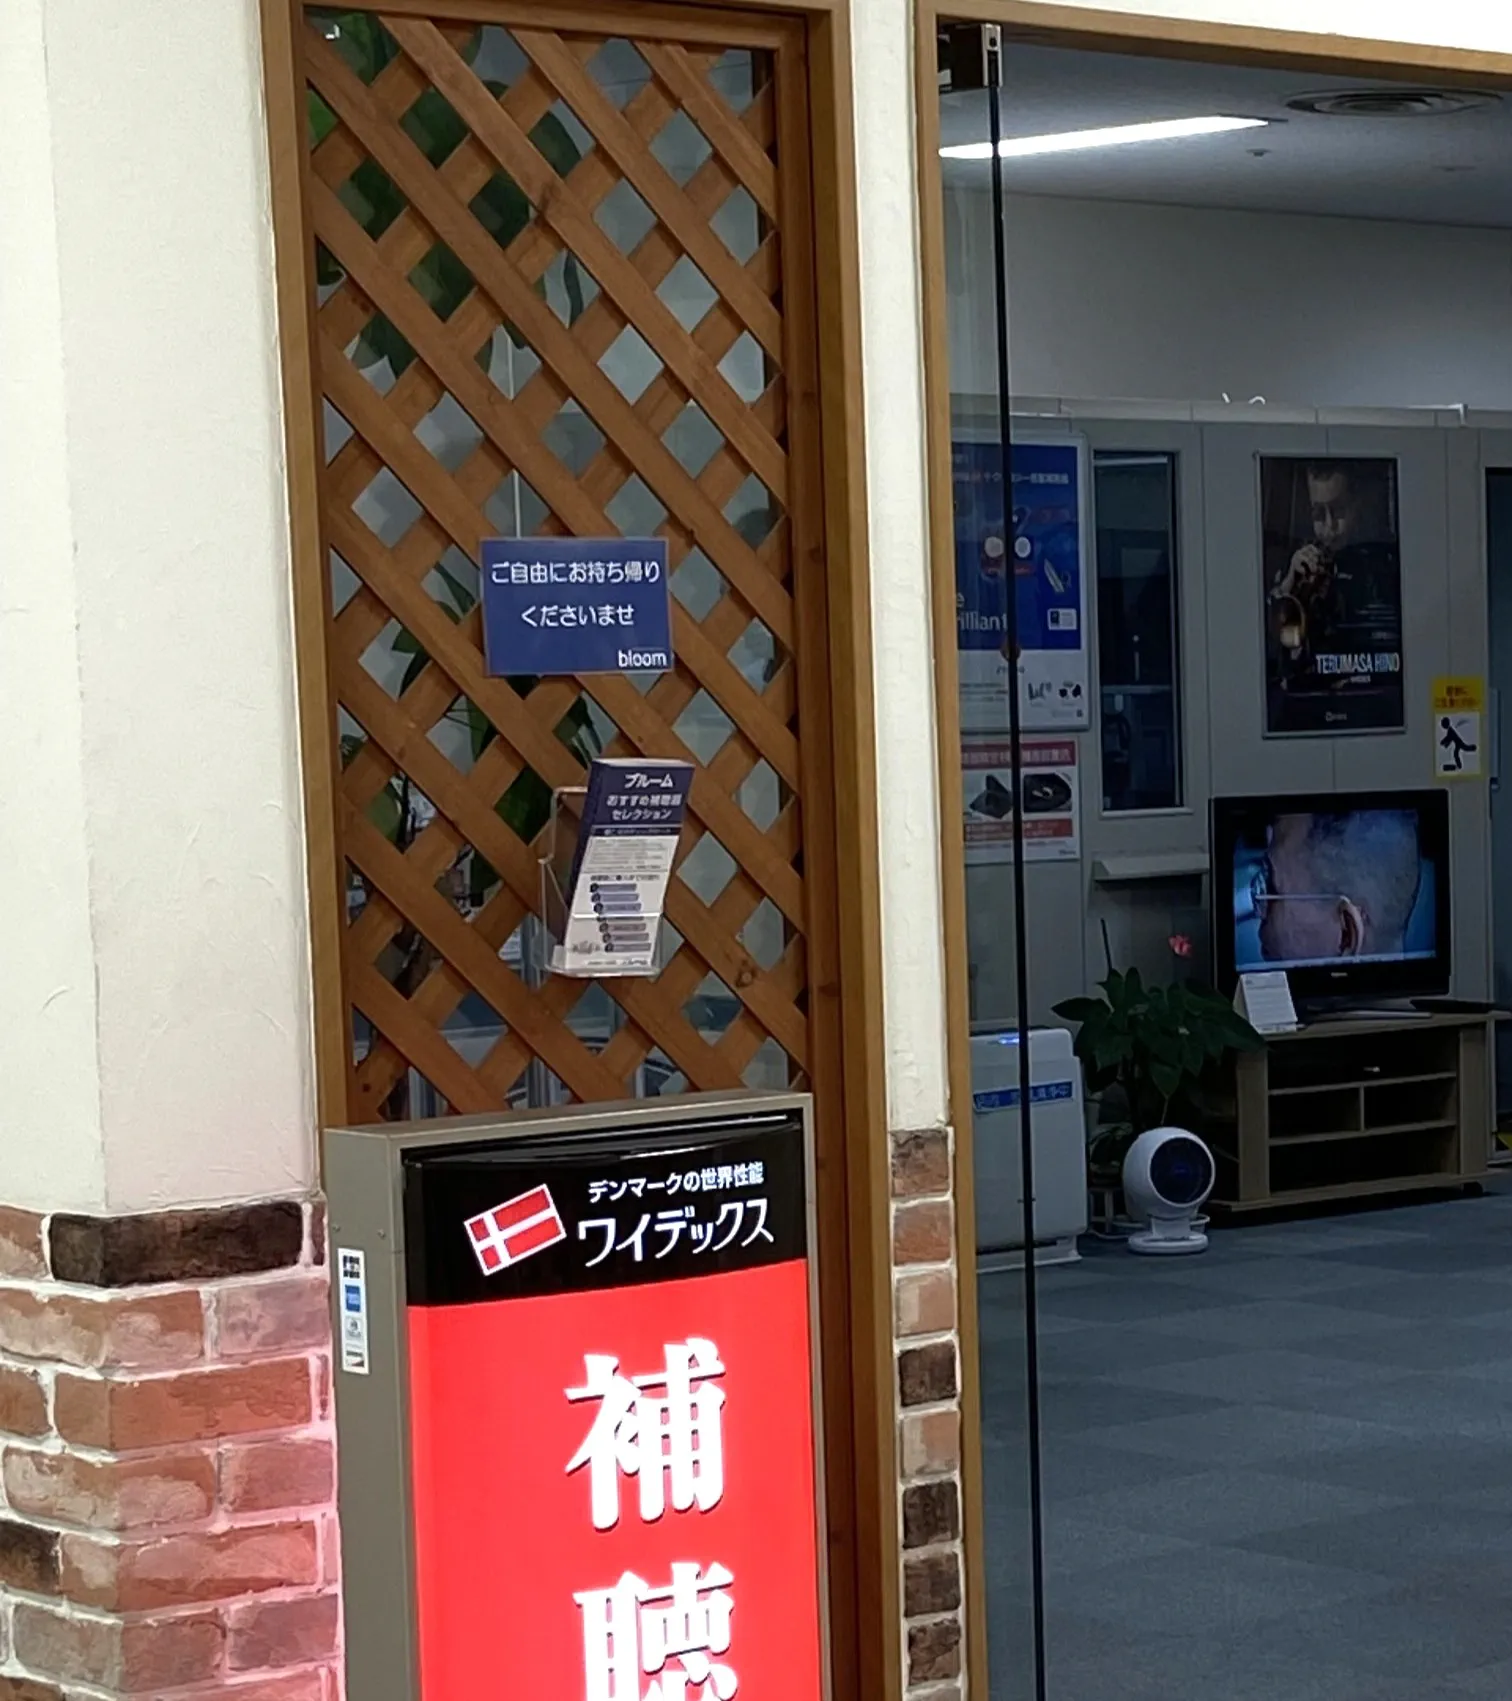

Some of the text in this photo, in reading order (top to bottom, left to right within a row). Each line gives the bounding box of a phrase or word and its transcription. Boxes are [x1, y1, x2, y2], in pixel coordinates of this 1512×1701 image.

[491, 560, 661, 585] ご自由にお持ち帰り
[520, 603, 636, 628] くださいませ
[617, 649, 668, 668] bloom
[624, 772, 674, 789] ブルーム
[588, 1160, 765, 1204] デンマークの世界性能
[577, 1197, 775, 1268] ワイデックス
[563, 1337, 741, 1701] 補聴
